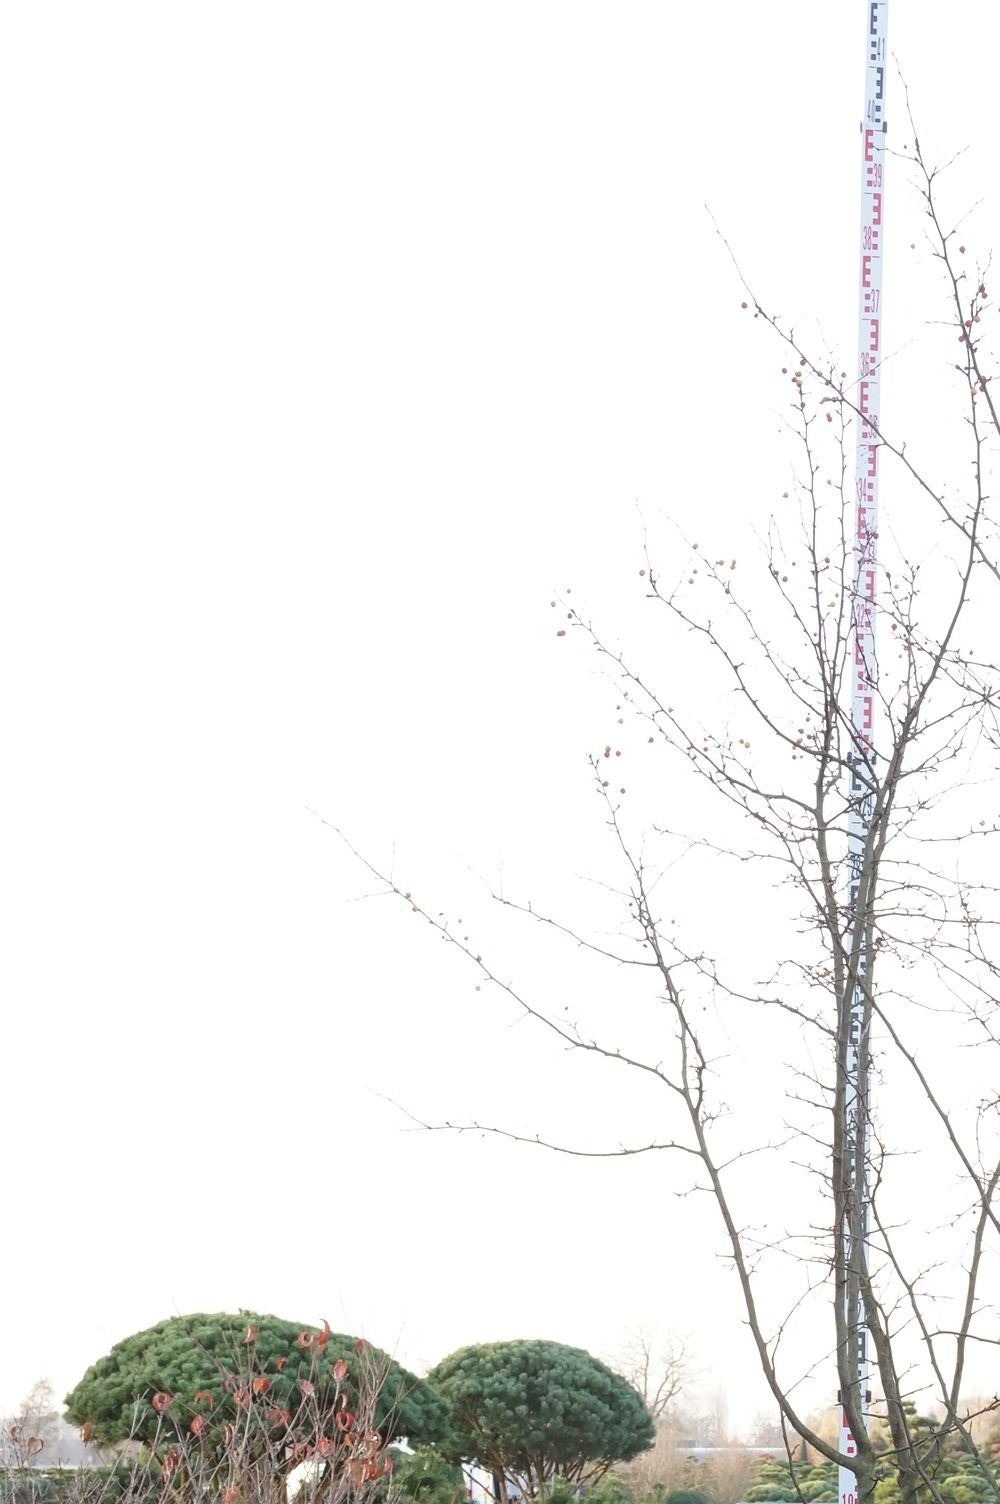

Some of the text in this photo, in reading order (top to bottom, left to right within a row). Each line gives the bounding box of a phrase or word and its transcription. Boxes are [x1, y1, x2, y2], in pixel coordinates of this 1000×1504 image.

[873, 163, 882, 187] 39
[863, 226, 872, 250] 38
[871, 289, 880, 313] 37
[860, 352, 870, 376] 36
